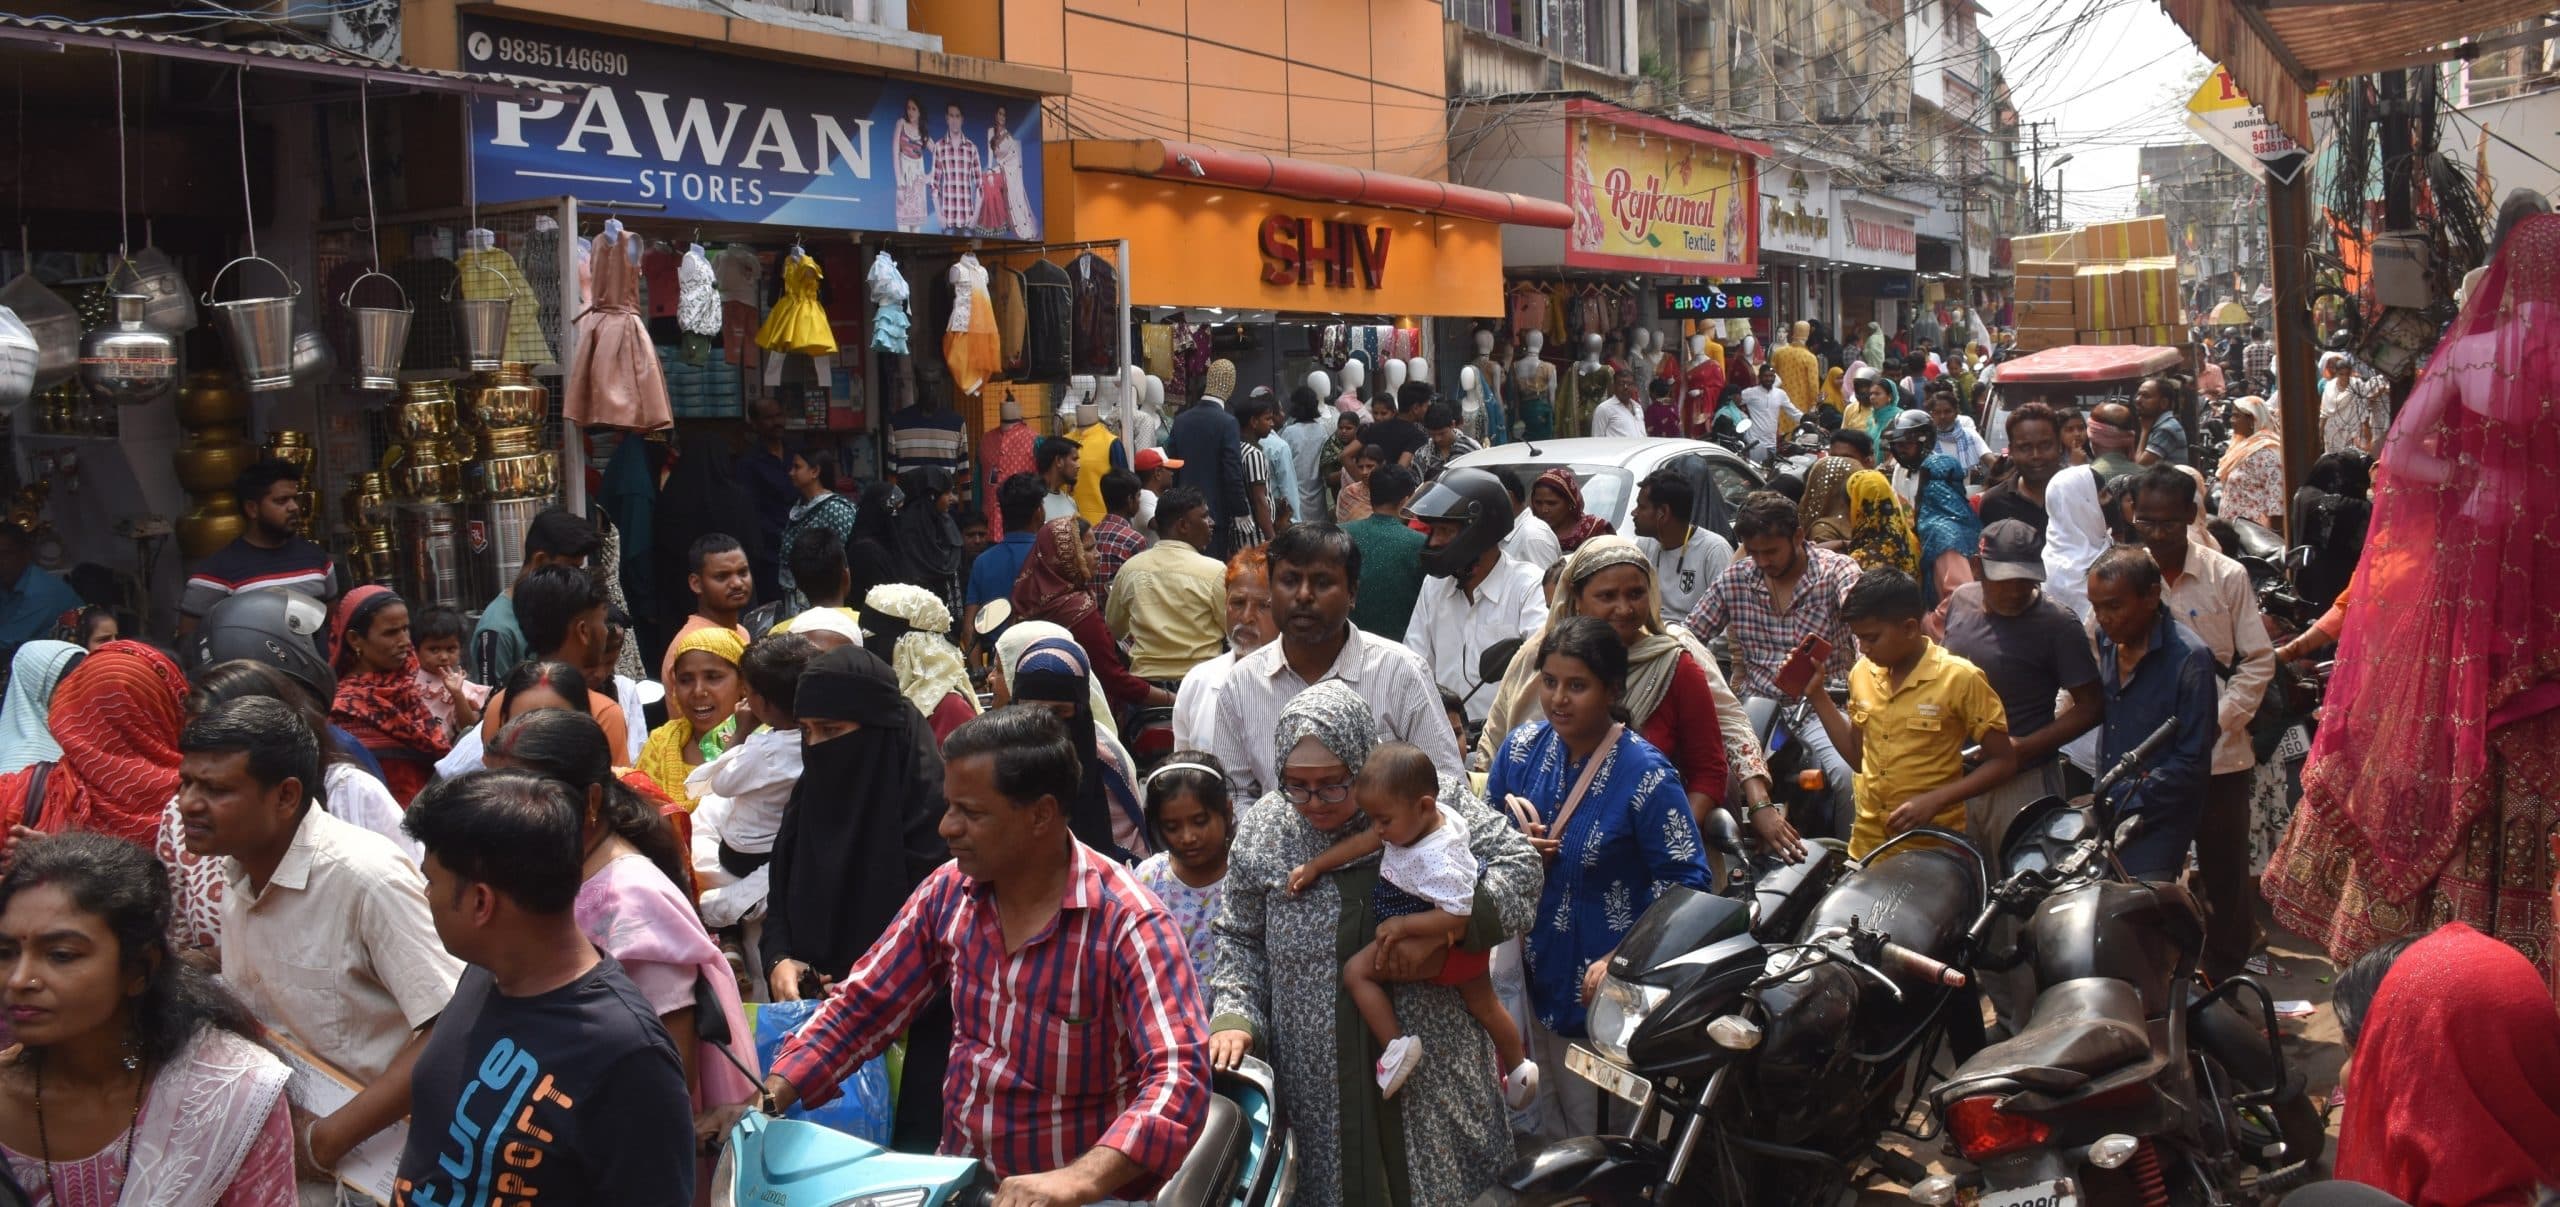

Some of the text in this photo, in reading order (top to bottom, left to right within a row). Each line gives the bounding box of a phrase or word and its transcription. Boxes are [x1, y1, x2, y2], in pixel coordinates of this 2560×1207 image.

[499, 37, 628, 76] 9835146690
[490, 84, 874, 180] PAWAN
[639, 168, 764, 206] STORES
[1604, 167, 1717, 239] Rajkamal
[1257, 214, 1393, 290] SHIV
[1682, 230, 1716, 253] Textile
[1664, 292, 1764, 313] Fancy Saree
